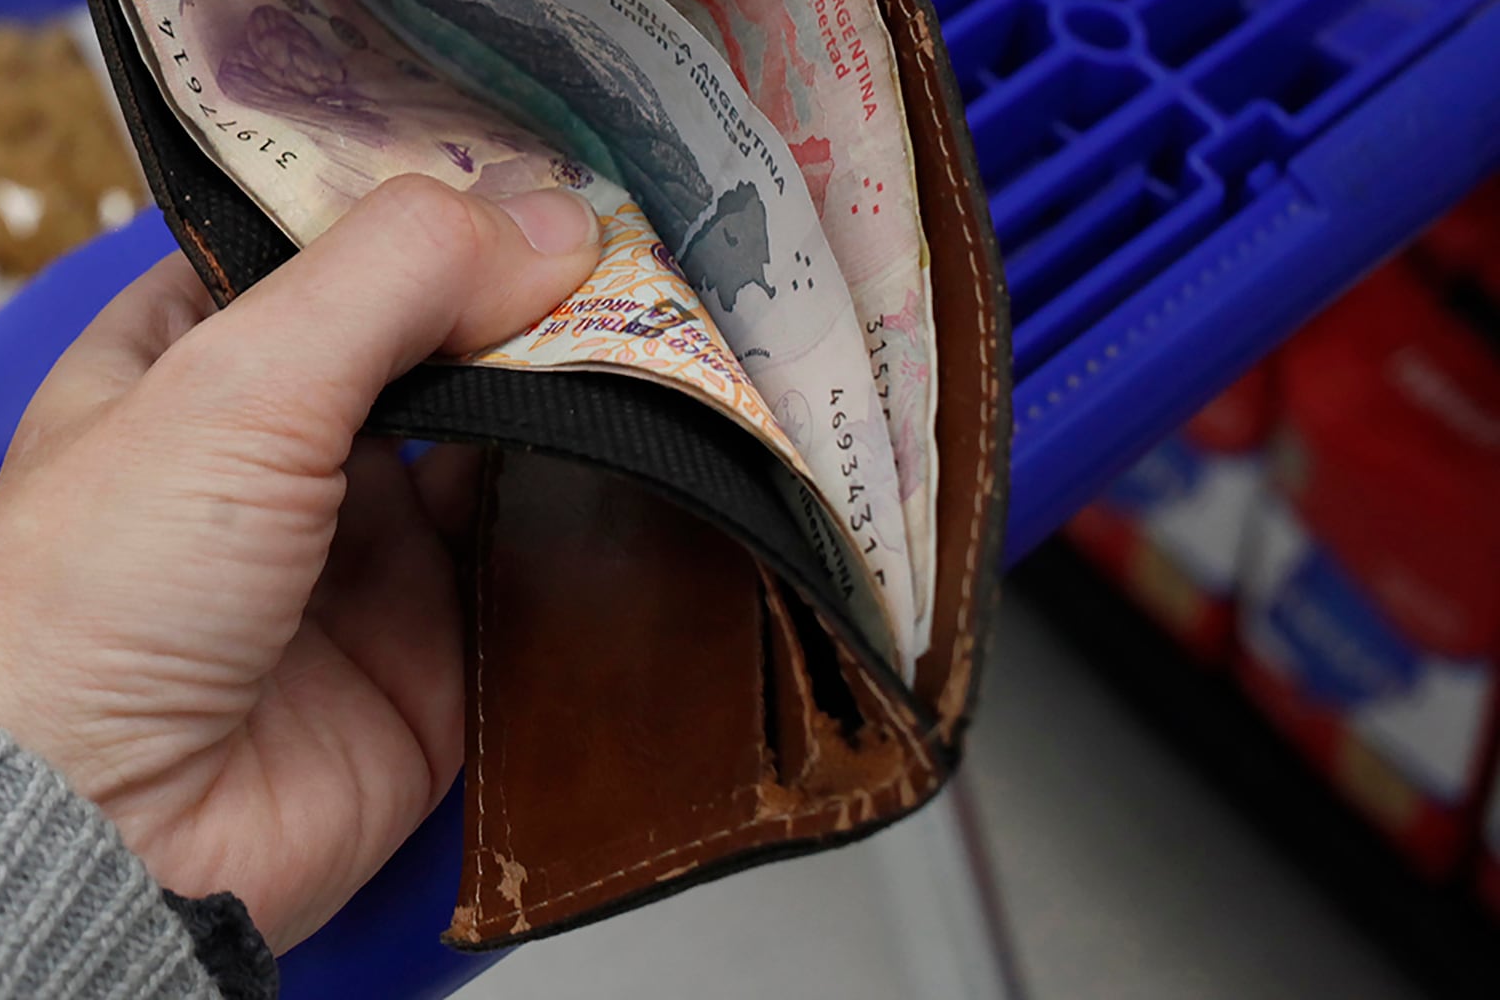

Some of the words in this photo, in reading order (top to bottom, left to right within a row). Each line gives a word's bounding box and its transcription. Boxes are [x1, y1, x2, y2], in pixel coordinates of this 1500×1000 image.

[675, 52, 686, 66] y
[690, 68, 752, 158] libertad
[697, 62, 786, 196] ARGENTINA
[539, 320, 569, 336] DE
[580, 317, 664, 338] CENTRAL
